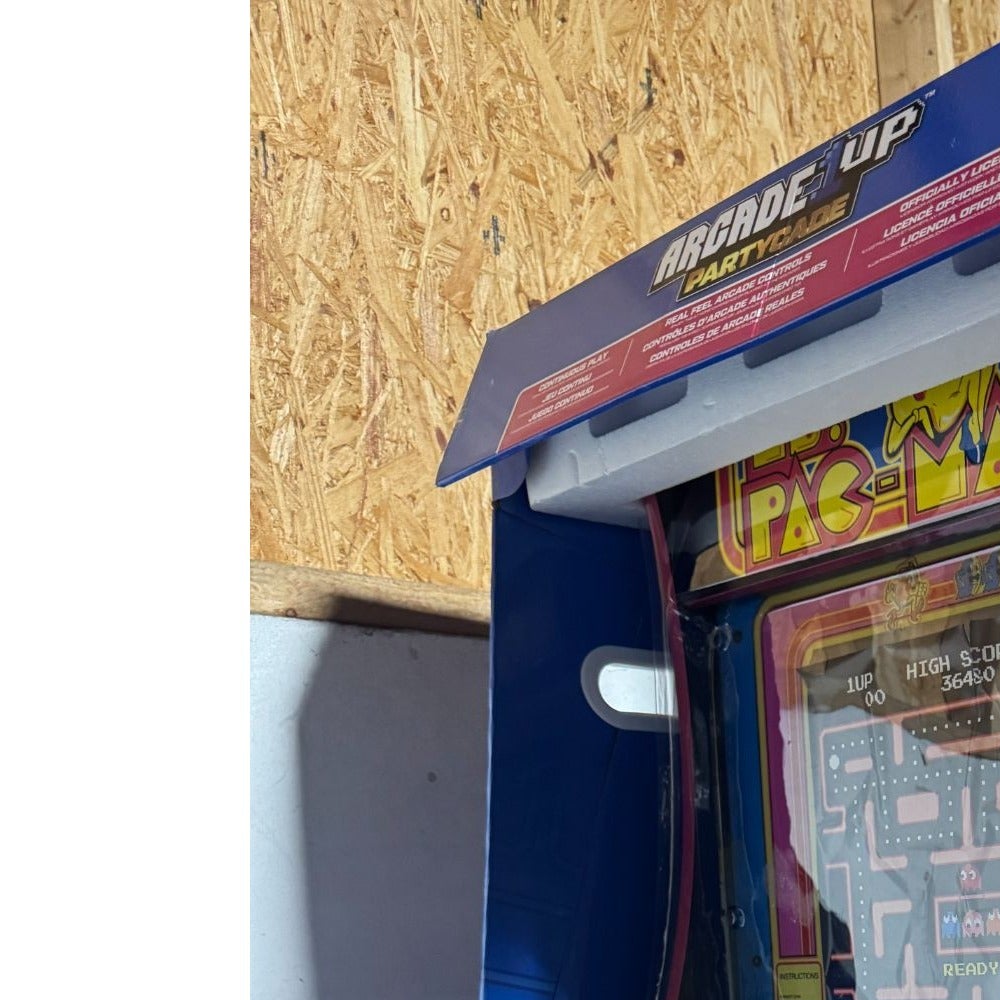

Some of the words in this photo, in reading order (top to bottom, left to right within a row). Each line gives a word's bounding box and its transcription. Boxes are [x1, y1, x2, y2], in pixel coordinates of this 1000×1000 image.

[900, 172, 968, 213] OFFICIALLY
[883, 206, 934, 239] LICENCÉ
[900, 213, 957, 248] LICENCIA
[683, 193, 850, 293] PARTYCADE
[643, 319, 697, 352] CONTRÔLES
[697, 299, 748, 328] D'ARCADE
[749, 260, 828, 304] AUTHENTIQUES
[665, 310, 688, 327] REAL
[691, 299, 713, 316] FEEL
[715, 281, 756, 305] ARCADE
[757, 252, 813, 285] CONTROLS
[650, 332, 706, 363] CONTROLES
[707, 326, 721, 338] DE
[721, 309, 763, 333] ARCADE
[764, 287, 806, 313] REALES
[539, 361, 587, 392] CONTINUOUS
[587, 352, 609, 368] PLAY
[557, 373, 593, 395] CONTINU
[528, 406, 554, 422] JUEGO
[554, 385, 595, 410] CONTINUO
[847, 672, 874, 694] 1UP
[906, 655, 951, 681] HIGH
[865, 689, 886, 707] 00
